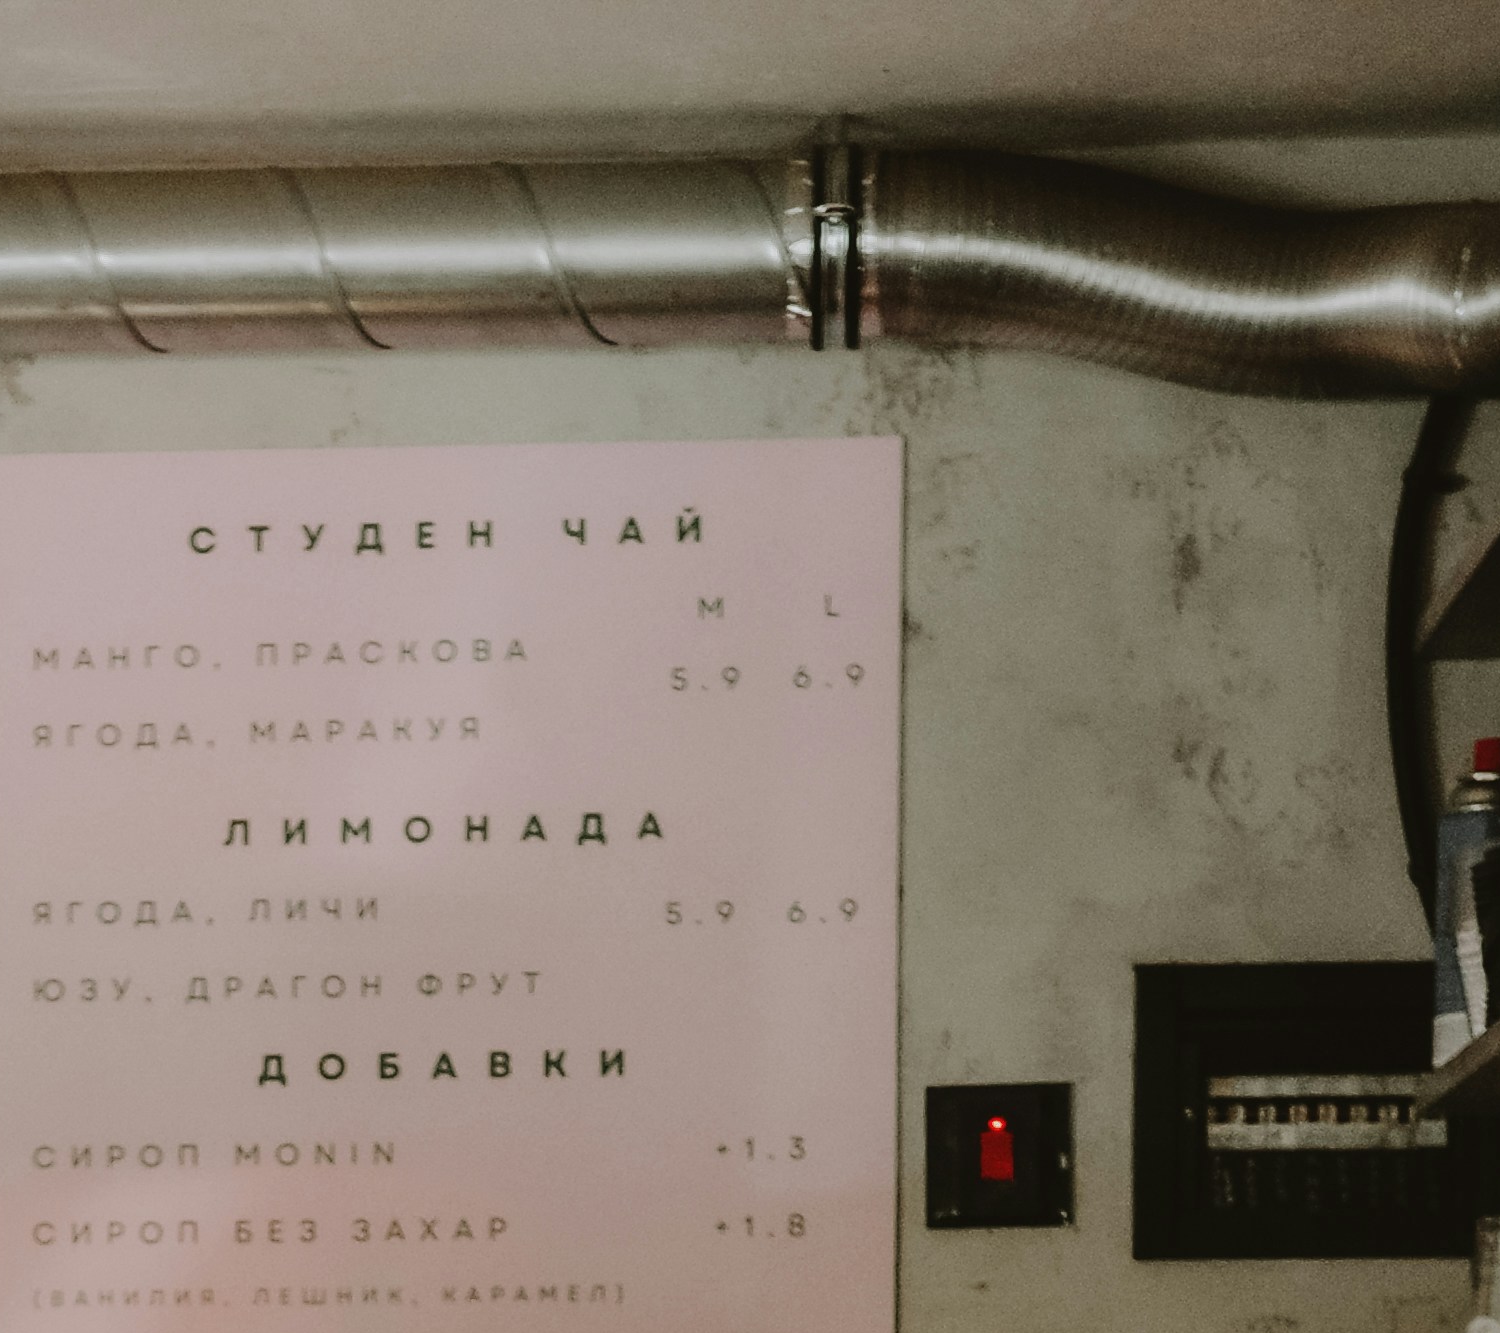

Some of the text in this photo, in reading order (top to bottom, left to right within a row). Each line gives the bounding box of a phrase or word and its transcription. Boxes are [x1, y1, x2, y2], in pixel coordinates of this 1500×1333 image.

[188, 507, 702, 555] СТУДЕН ЧАЙ
[256, 638, 527, 666] ПРАСКОВА
[670, 665, 741, 692] 5.9
[792, 662, 865, 690] 6.9
[249, 715, 479, 743] МАРАКУЯ
[224, 811, 663, 846] ЛИМОНАДА
[248, 897, 378, 922] ЛИЧИ
[786, 897, 859, 924] 6.9
[184, 973, 382, 1004] ДРАГОН
[416, 970, 540, 998] ФРУТ
[257, 1049, 625, 1086] ДОБАВКИ
[32, 1135, 806, 1170] СИРОП MONIN +1.3
[31, 1216, 508, 1247] СИРОП БЕЗ ЗАХАР
